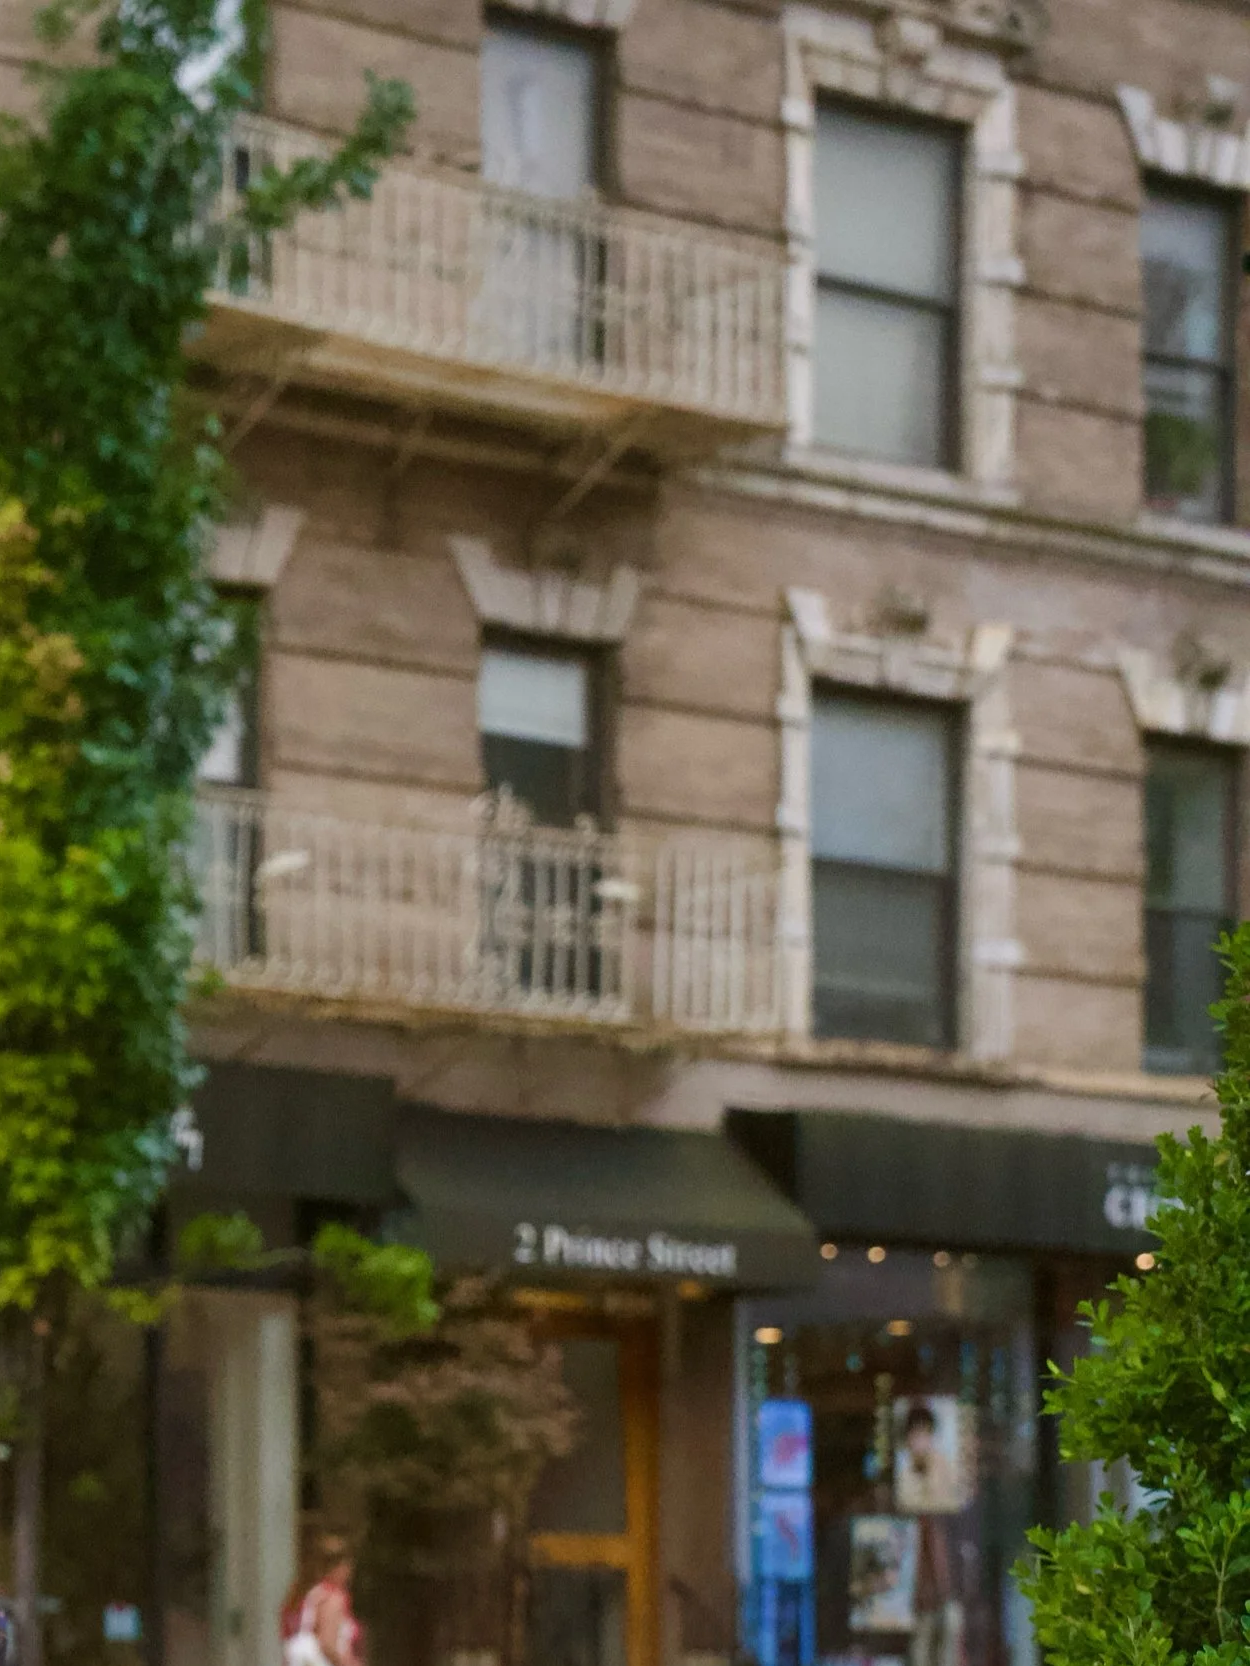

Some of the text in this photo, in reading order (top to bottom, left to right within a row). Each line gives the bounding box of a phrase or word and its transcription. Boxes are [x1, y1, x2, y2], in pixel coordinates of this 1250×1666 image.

[514, 1222, 737, 1276] 2 Prince Street
